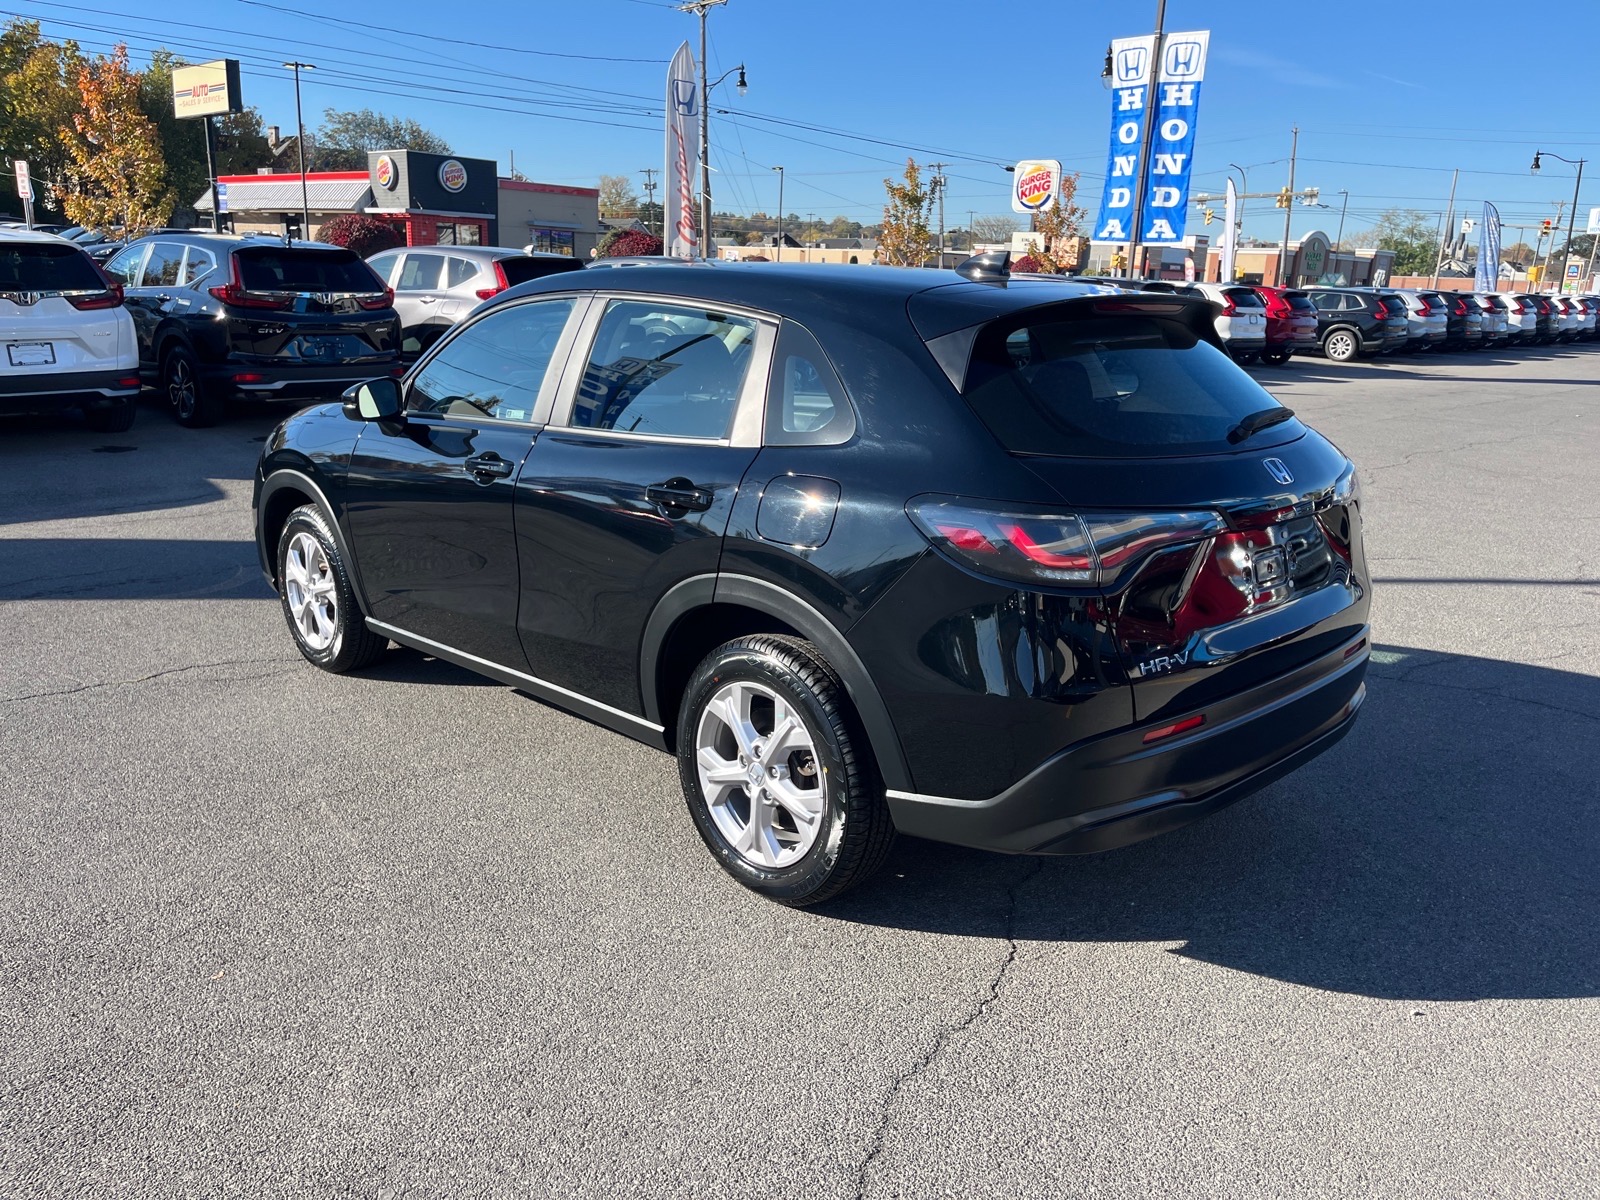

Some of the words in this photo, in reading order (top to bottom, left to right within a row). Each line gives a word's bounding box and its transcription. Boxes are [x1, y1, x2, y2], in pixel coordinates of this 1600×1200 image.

[192, 84, 209, 98] AUTO
[182, 99, 197, 107] SALES
[203, 95, 221, 104] SERVICE
[377, 162, 389, 172] BURGER
[1099, 86, 1144, 239] HONDA
[1146, 84, 1194, 239] HONDA
[378, 167, 390, 179] KING
[444, 167, 463, 176] BURGER
[445, 174, 464, 184] KING
[1020, 171, 1051, 188] BURGER
[1020, 180, 1052, 200] KING
[1140, 650, 1189, 676] HR-V
